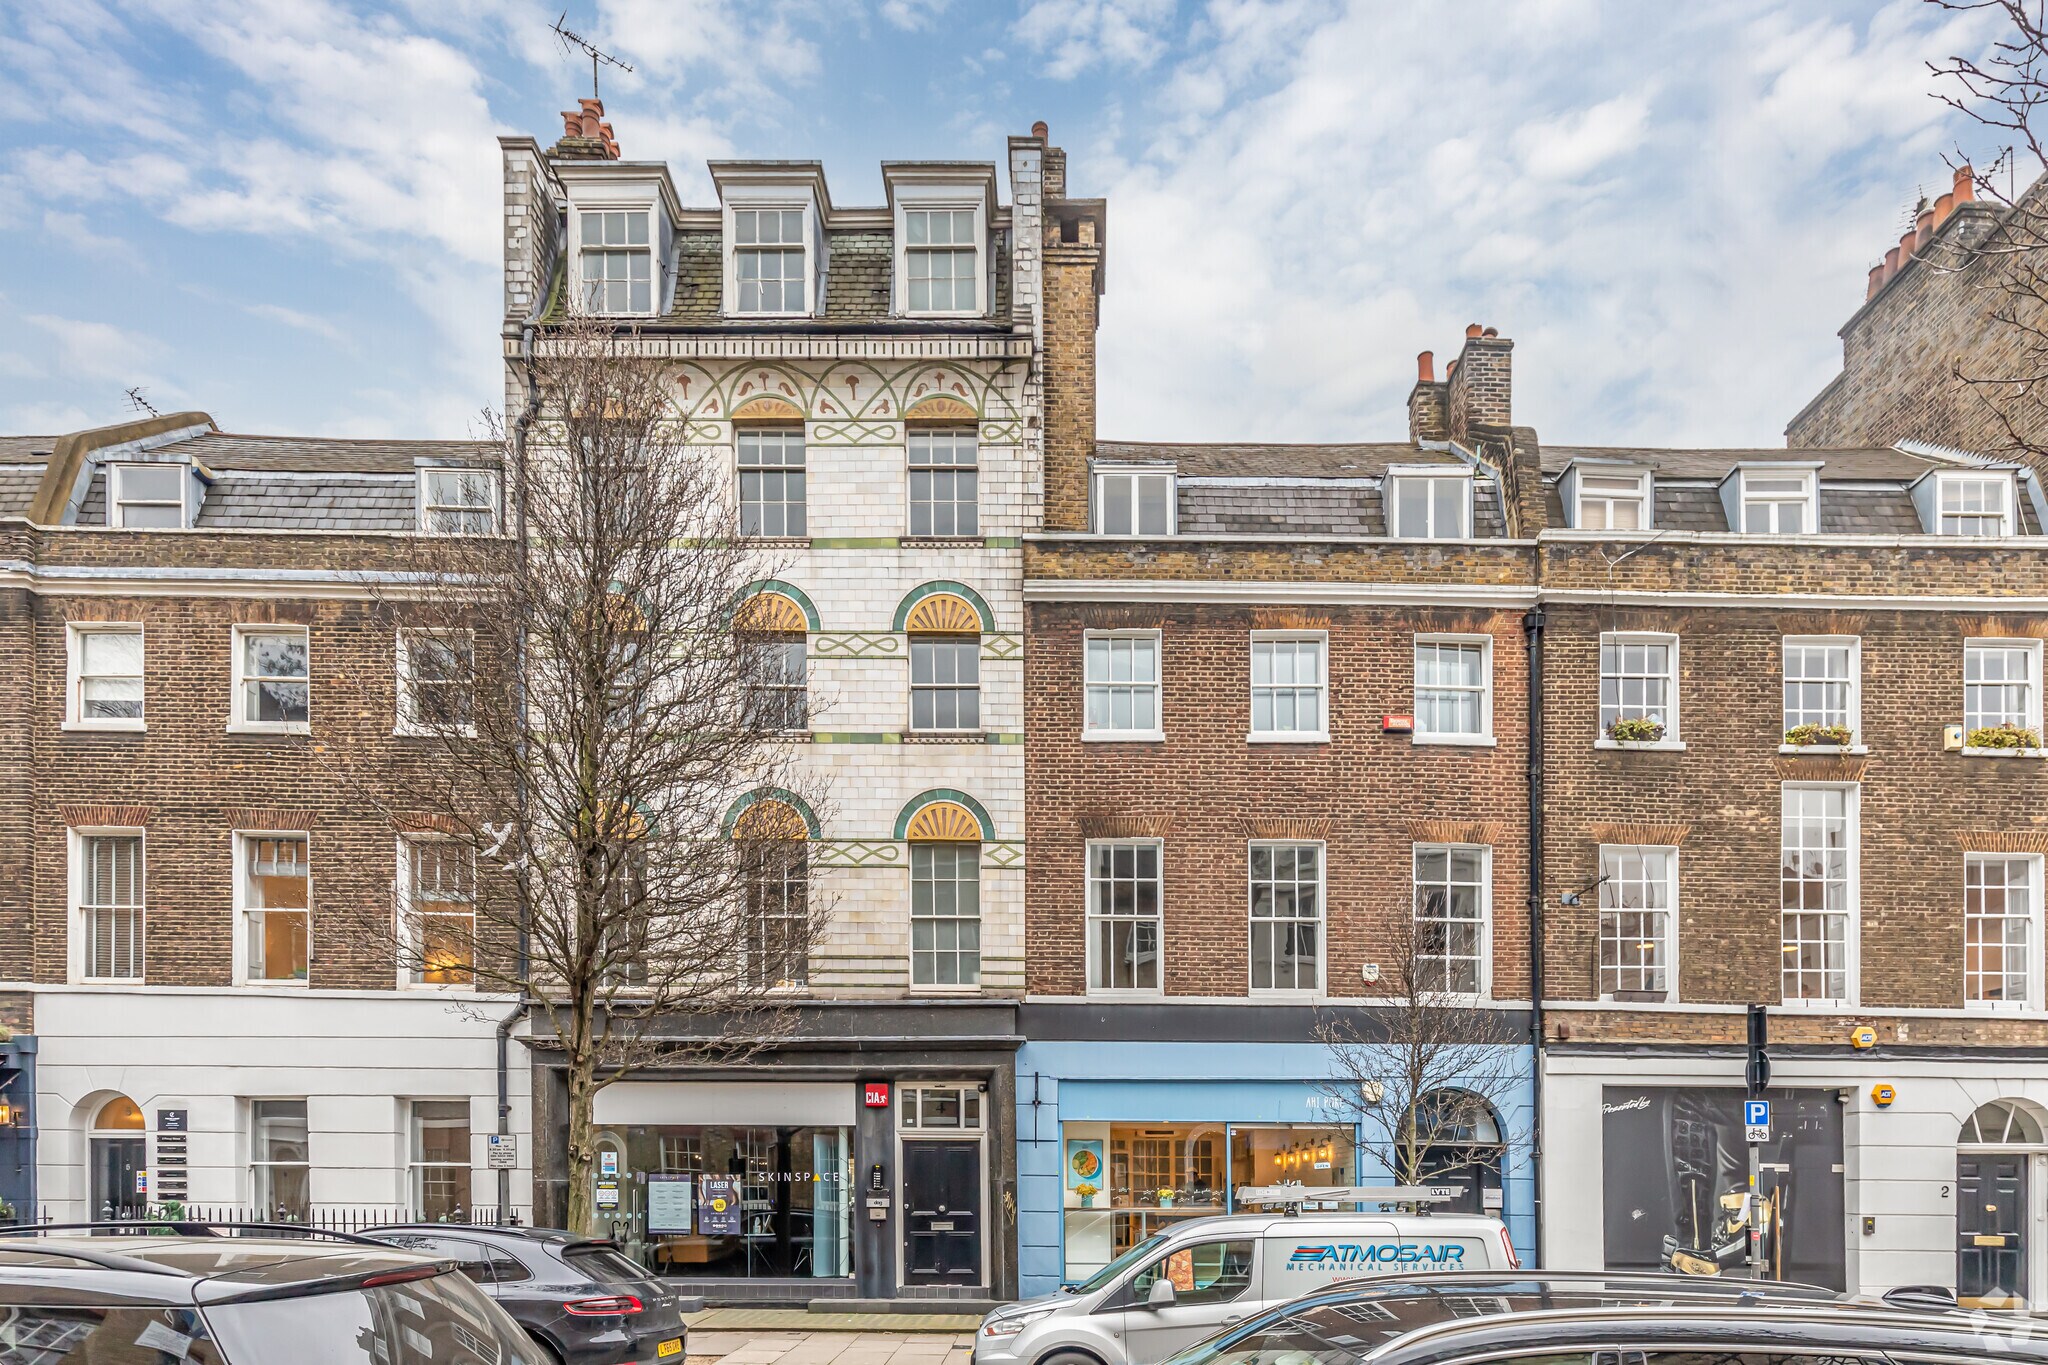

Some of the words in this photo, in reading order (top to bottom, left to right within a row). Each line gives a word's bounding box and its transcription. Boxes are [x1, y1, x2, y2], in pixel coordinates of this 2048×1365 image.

[866, 1091, 880, 1104] CIA
[1306, 1096, 1320, 1108] AHI
[1750, 1103, 1765, 1123] P
[710, 1181, 729, 1189] LASER
[1941, 1185, 1949, 1198] 2
[1318, 1244, 1465, 1263] ATMOSAIR
[1286, 1262, 1383, 1271] MECHANICAL
[1394, 1262, 1465, 1271] SERVICES
